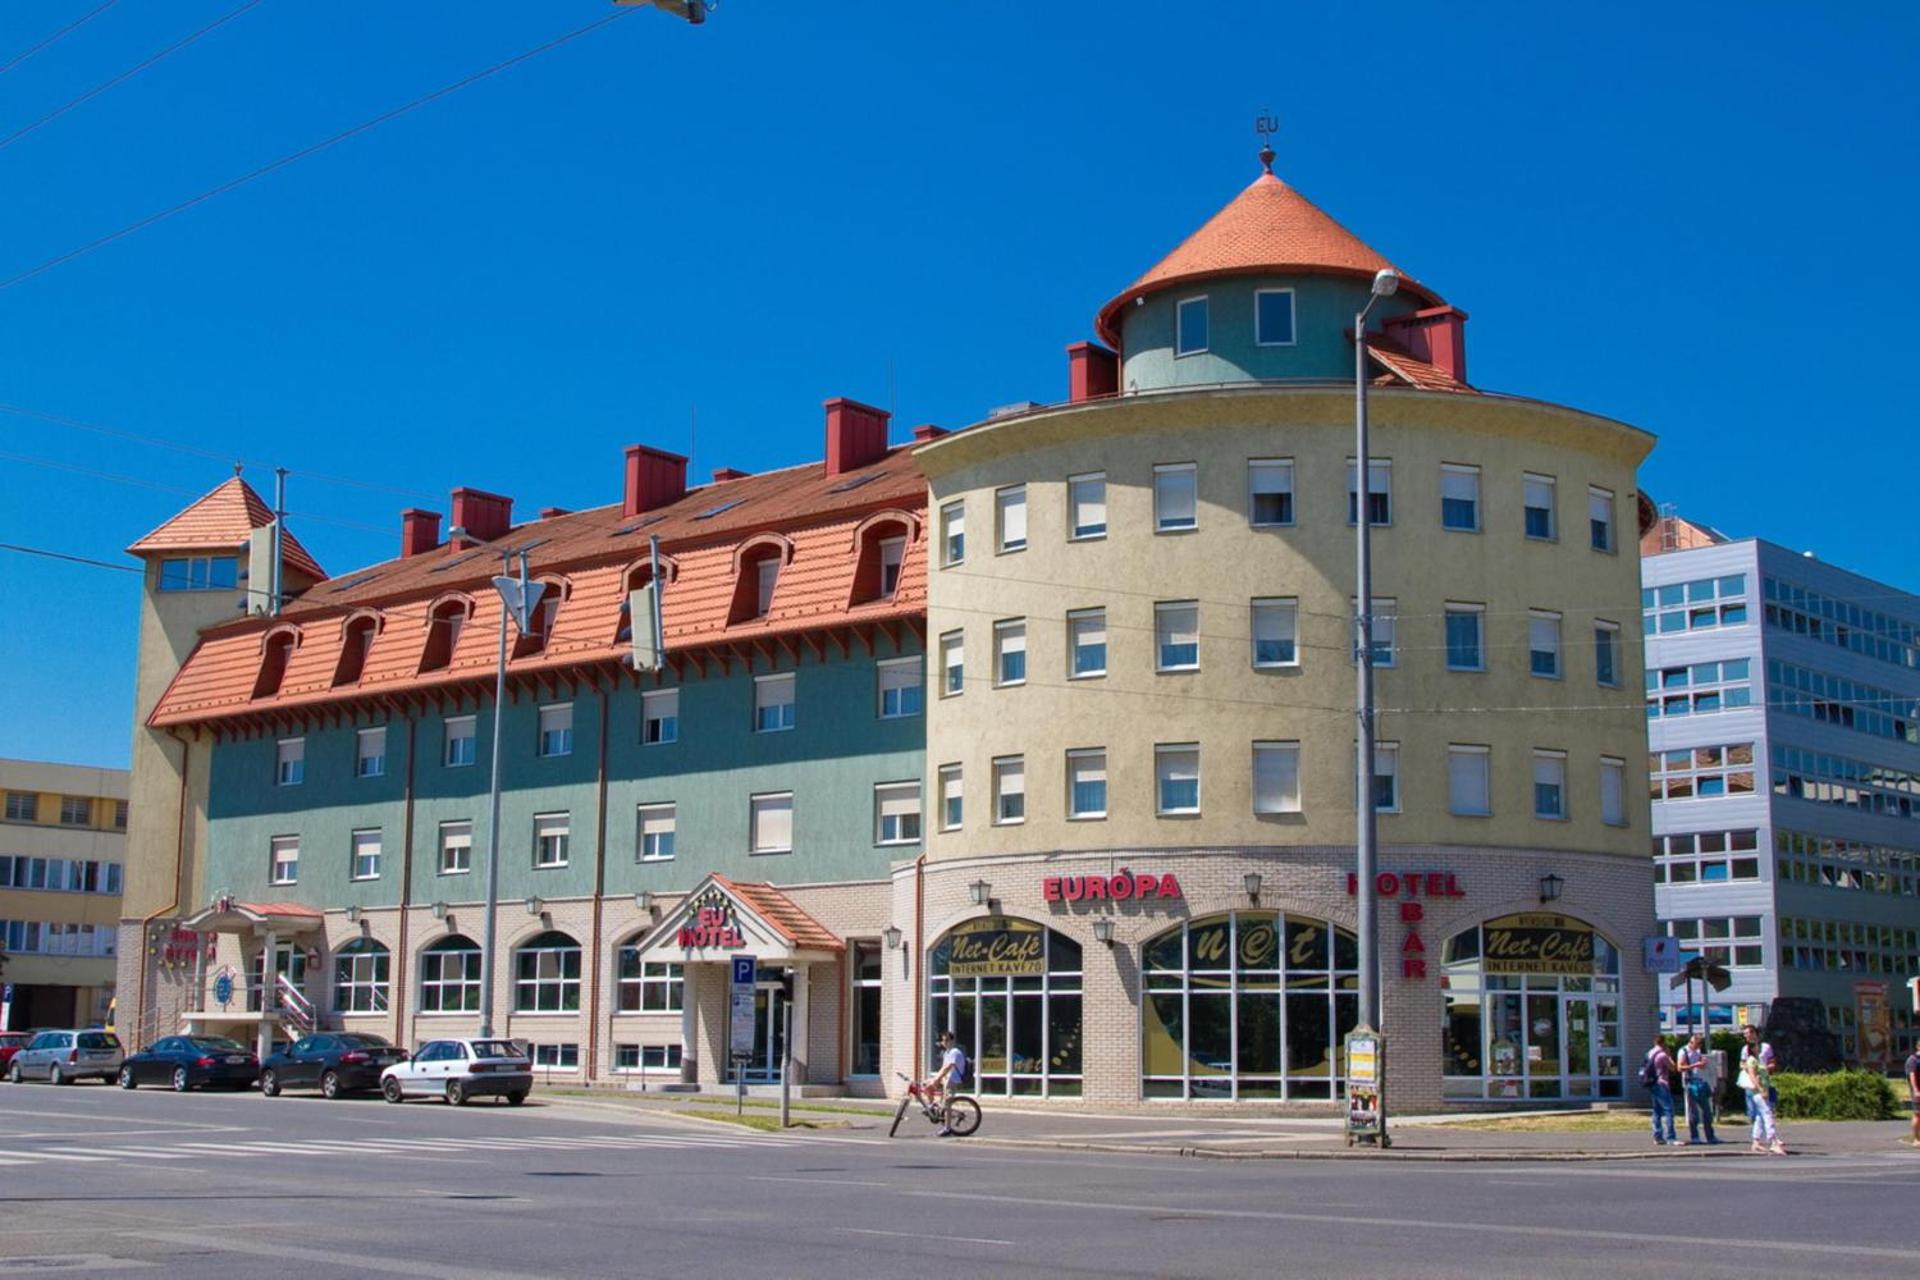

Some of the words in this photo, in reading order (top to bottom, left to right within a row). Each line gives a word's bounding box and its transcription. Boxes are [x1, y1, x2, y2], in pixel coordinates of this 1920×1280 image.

[1256, 116, 1279, 133] EU
[1043, 866, 1181, 901] EURÓPA
[699, 907, 727, 928] EU
[1401, 902, 1427, 978] BAR
[738, 962, 750, 981] P
[1486, 960, 1548, 972] INTERNET
